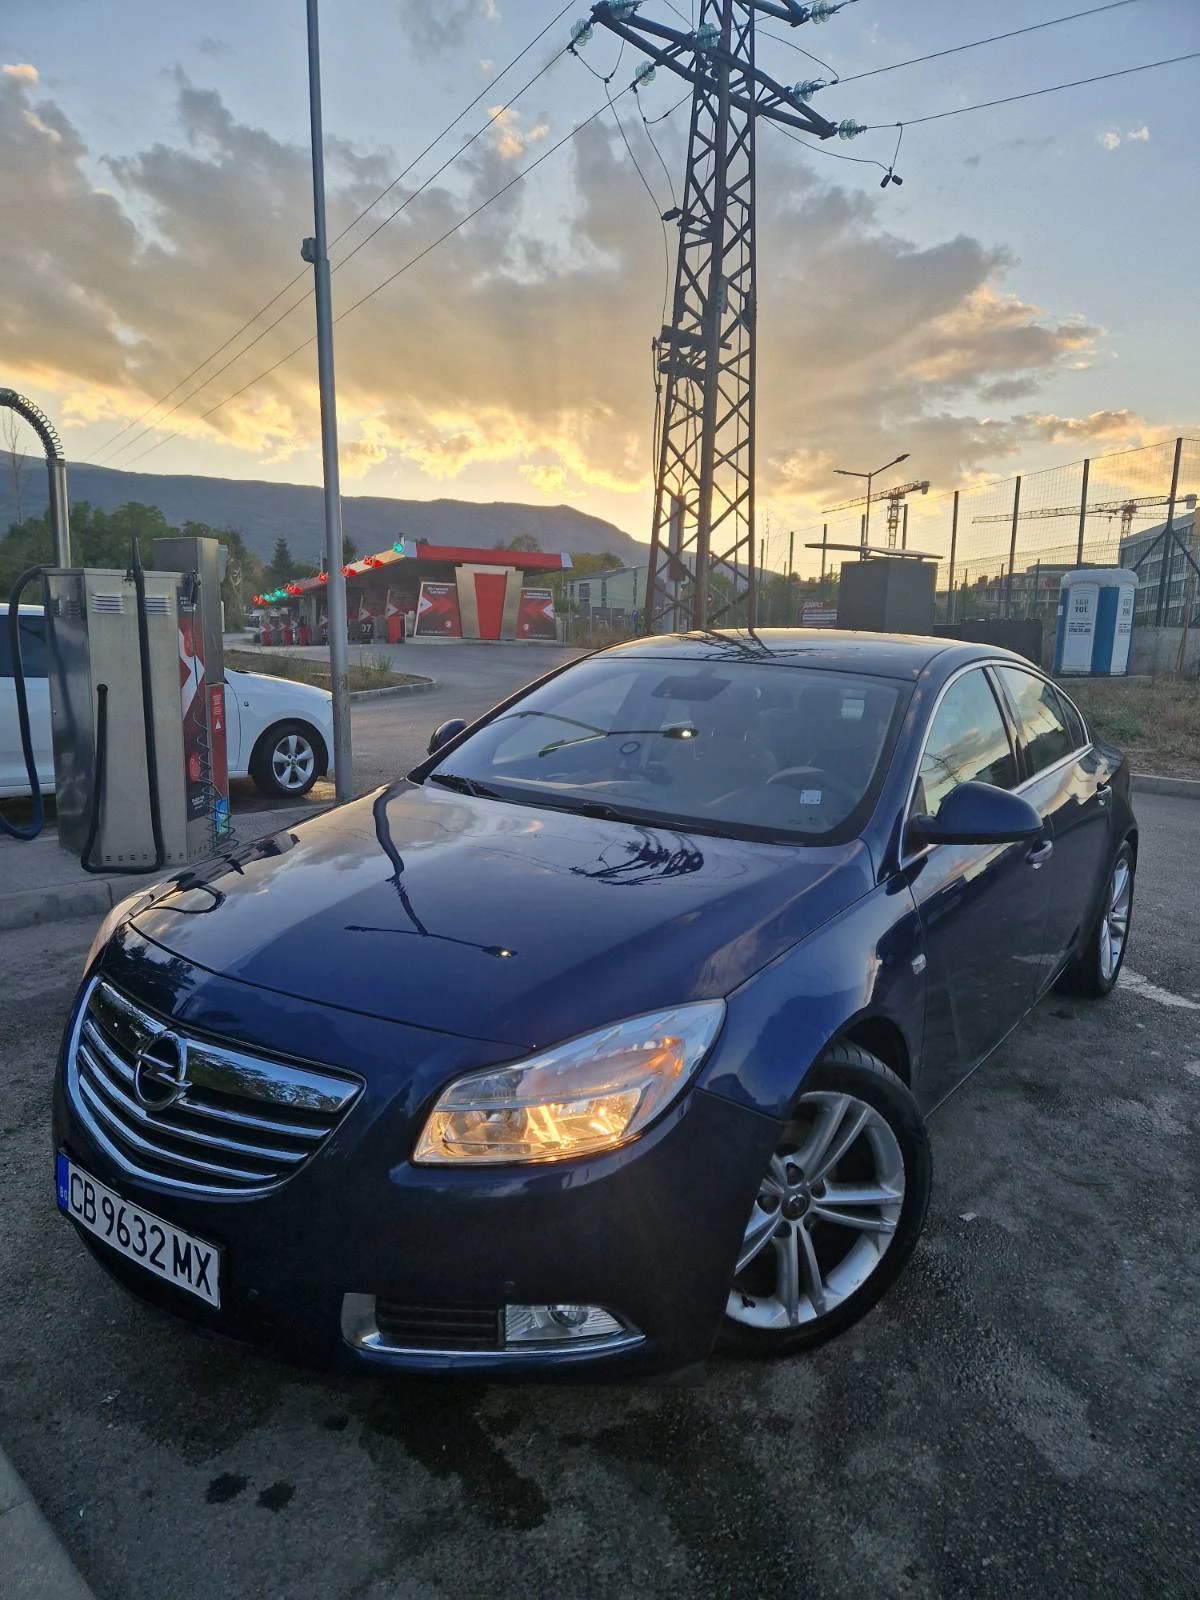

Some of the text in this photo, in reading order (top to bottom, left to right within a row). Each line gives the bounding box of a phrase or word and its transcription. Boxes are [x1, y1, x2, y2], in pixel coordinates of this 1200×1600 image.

[70, 1172, 213, 1297] CB 9632 MX
